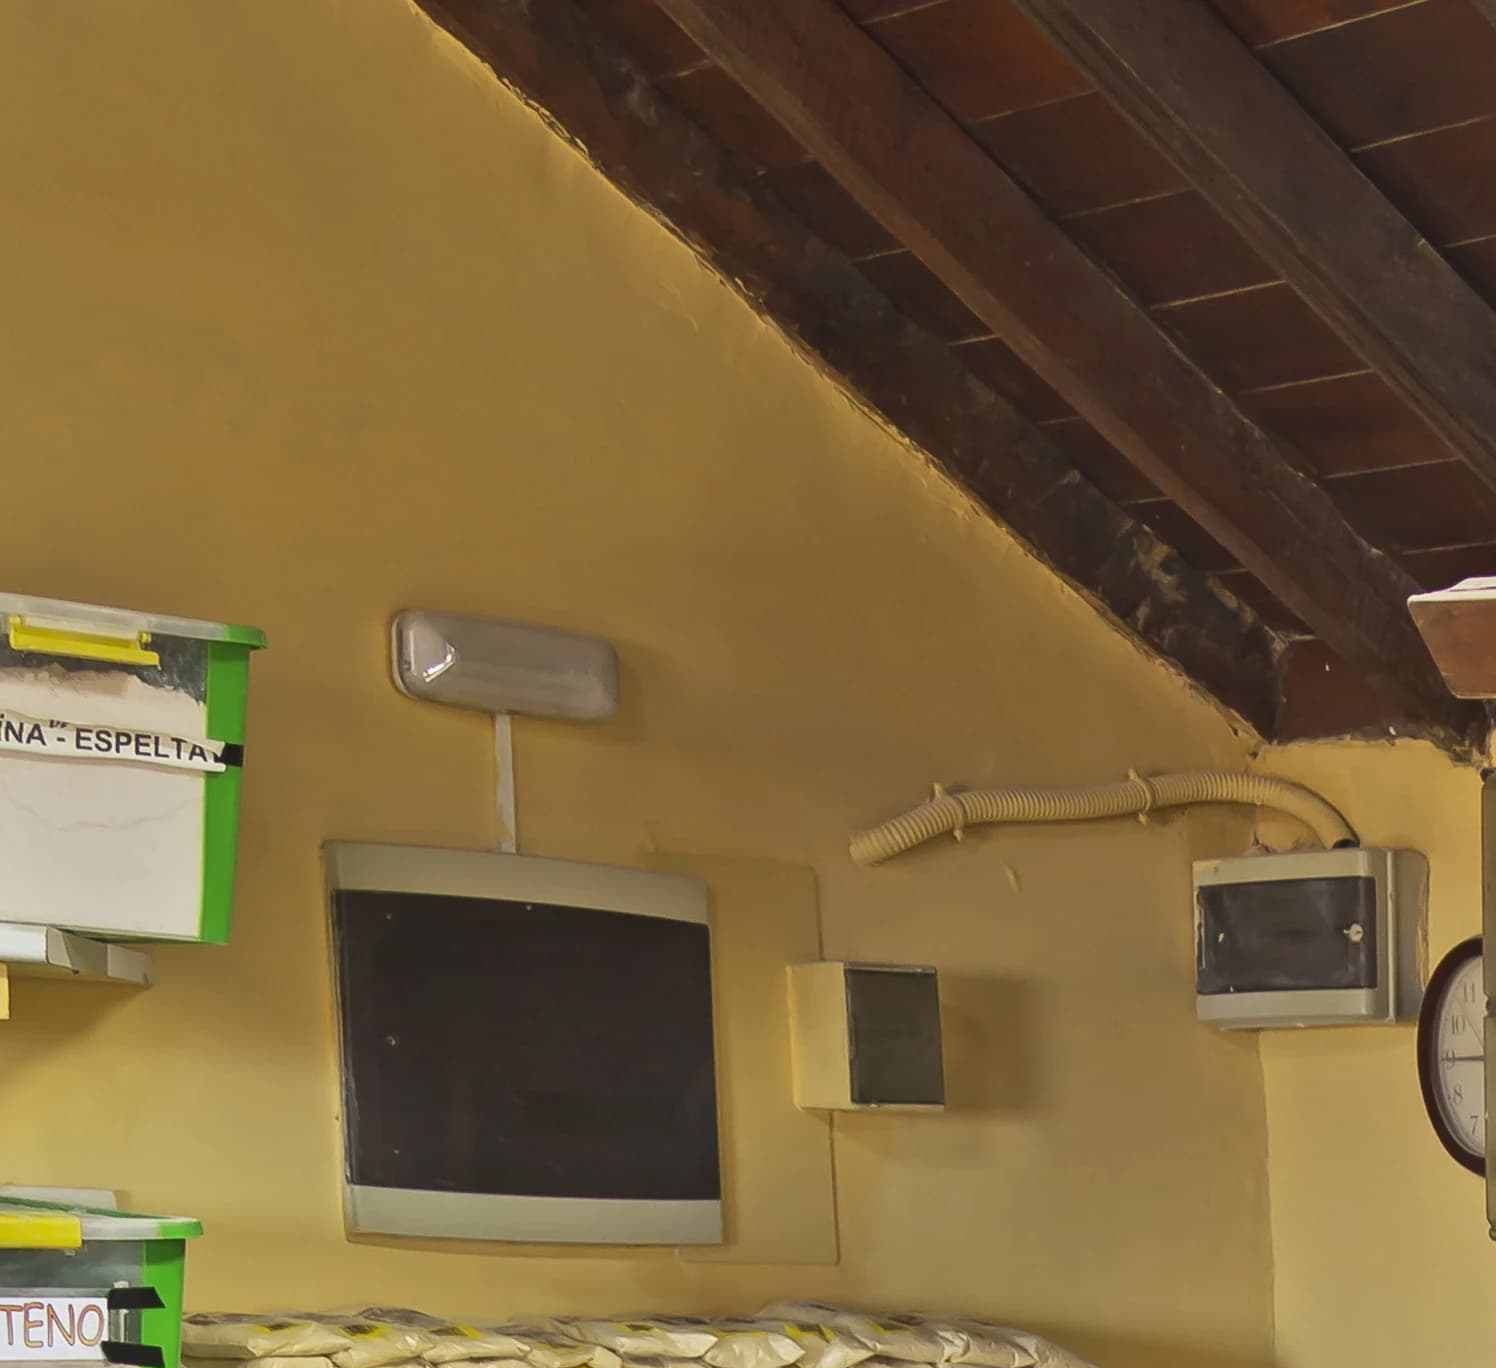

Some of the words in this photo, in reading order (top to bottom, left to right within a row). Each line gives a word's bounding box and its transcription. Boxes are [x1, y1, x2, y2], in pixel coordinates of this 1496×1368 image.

[0, 714, 47, 746] NA
[75, 727, 208, 763] ESPELTA
[1451, 1015, 1466, 1036] 10
[1469, 1114, 1479, 1136] 7
[0, 1302, 104, 1348] TENO
